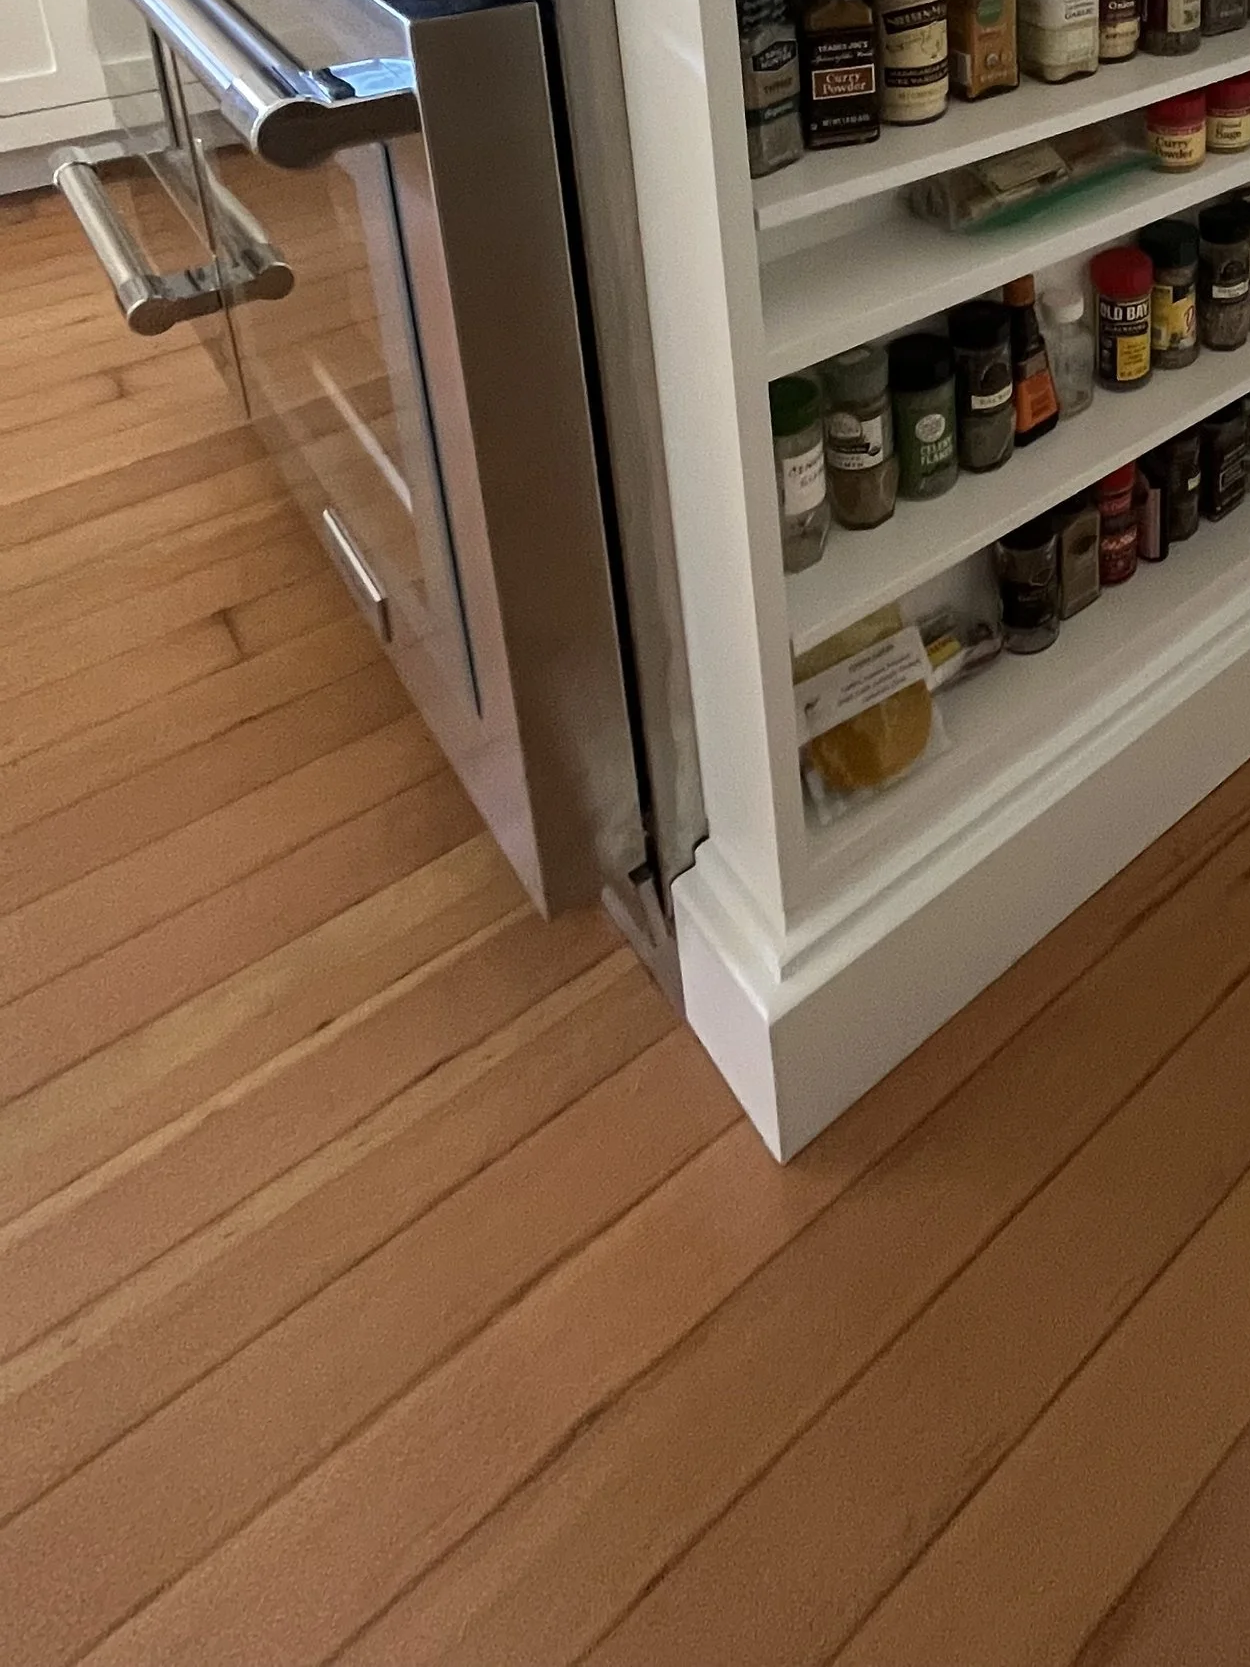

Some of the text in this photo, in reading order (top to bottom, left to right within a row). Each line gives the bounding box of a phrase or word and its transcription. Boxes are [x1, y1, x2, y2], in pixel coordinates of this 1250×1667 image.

[1065, 8, 1092, 20] GARLIC
[825, 71, 861, 84] Curry
[822, 81, 867, 95] Powder
[1156, 135, 1190, 148] Curry
[1100, 302, 1148, 321] OLD BAY
